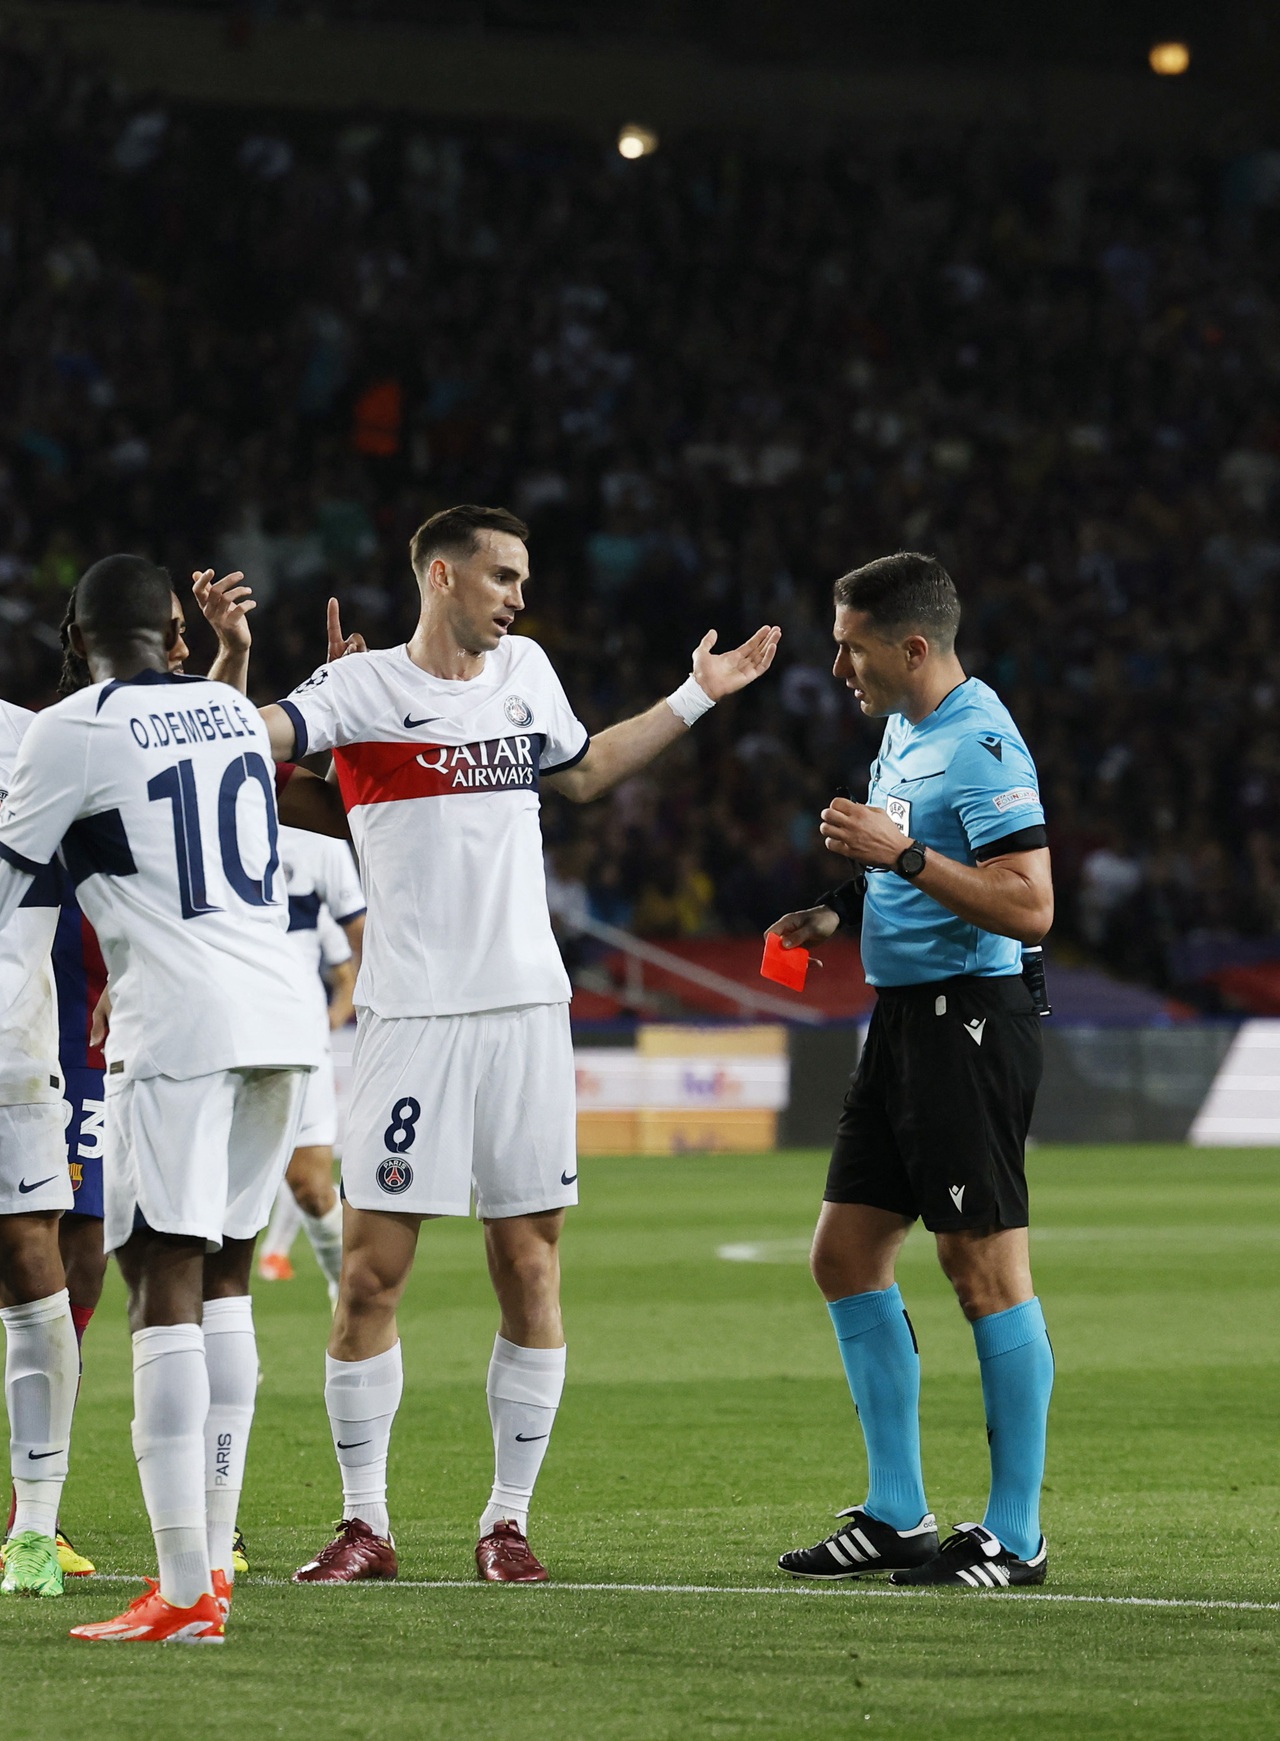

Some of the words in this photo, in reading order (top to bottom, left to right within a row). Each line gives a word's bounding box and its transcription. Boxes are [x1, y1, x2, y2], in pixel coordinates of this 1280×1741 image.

[416, 735, 533, 775] QATAR
[452, 766, 534, 787] AIRWAYS
[147, 752, 282, 920] 10
[384, 1096, 421, 1155] 8
[383, 1160, 407, 1169] PARIS
[215, 1433, 232, 1486] PARIS
